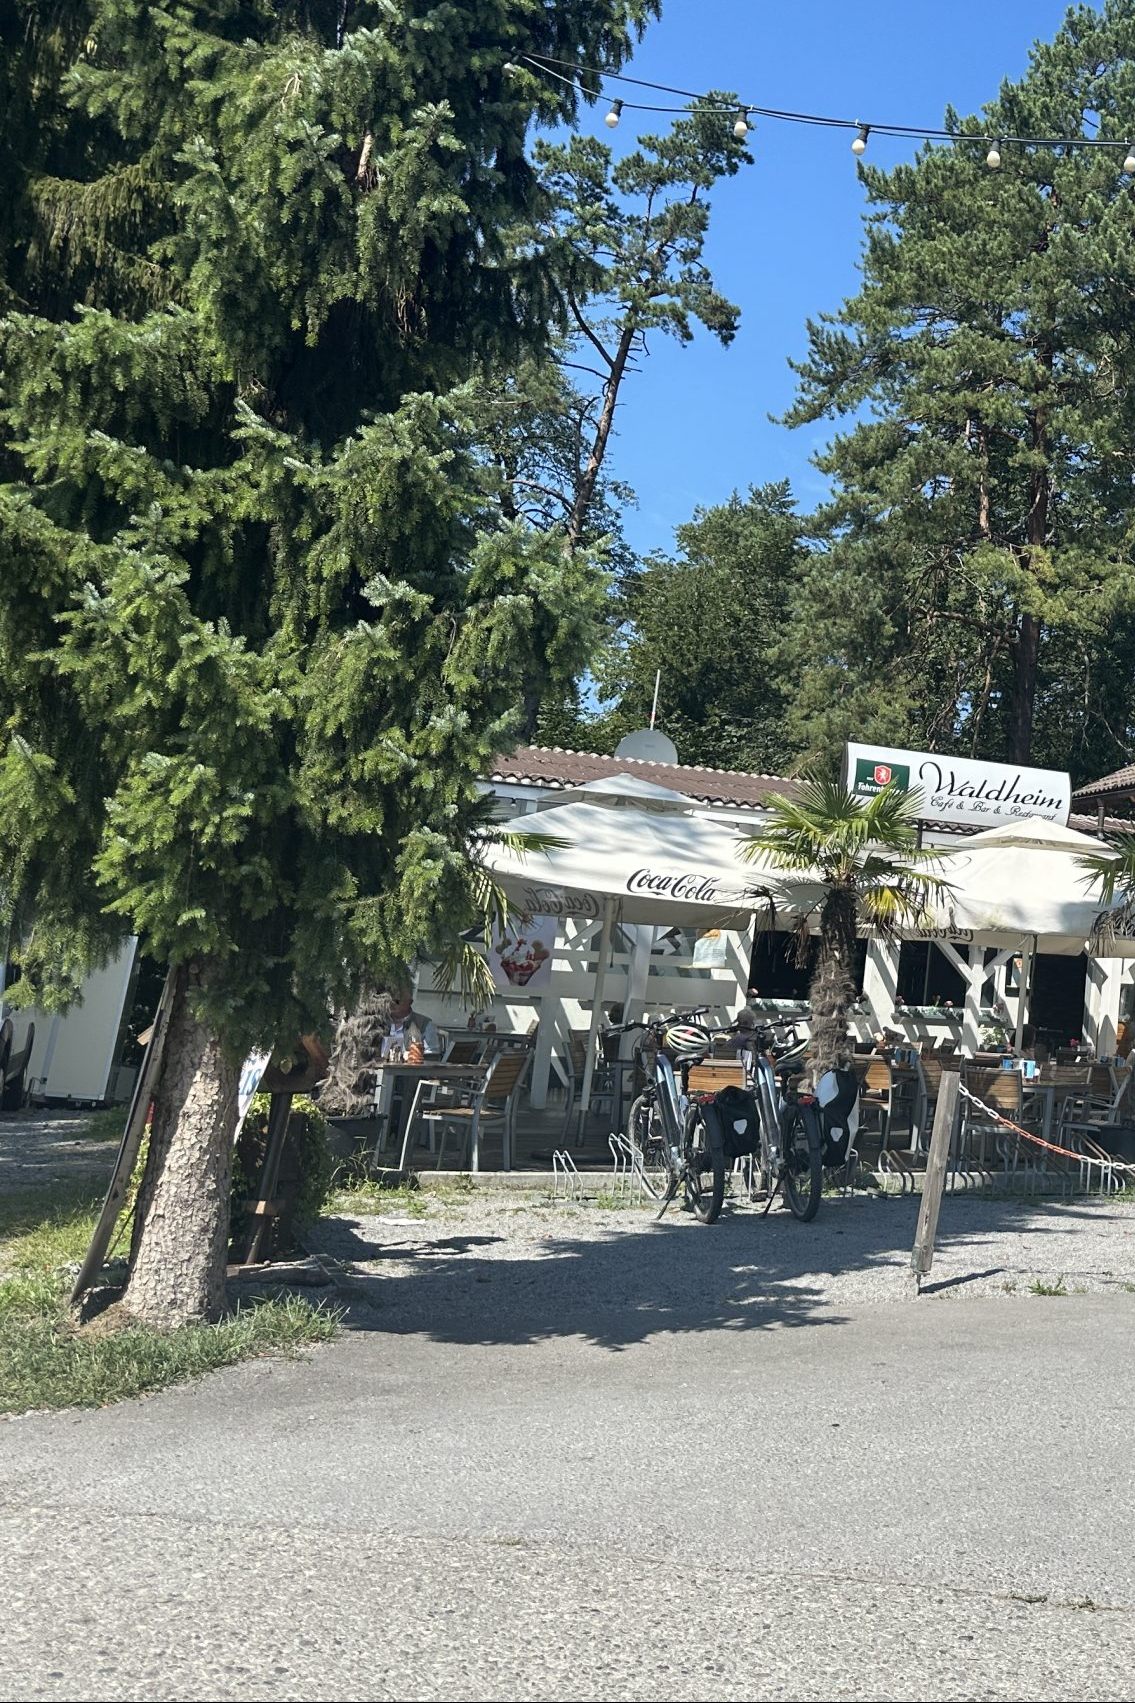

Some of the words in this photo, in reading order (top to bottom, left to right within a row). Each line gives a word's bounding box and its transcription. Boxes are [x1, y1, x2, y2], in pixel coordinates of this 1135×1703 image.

[919, 762, 1063, 810] Waldheim
[956, 801, 965, 810] &
[968, 801, 991, 812] Bar
[993, 805, 1002, 815] &
[626, 868, 720, 901] Coca-Cola
